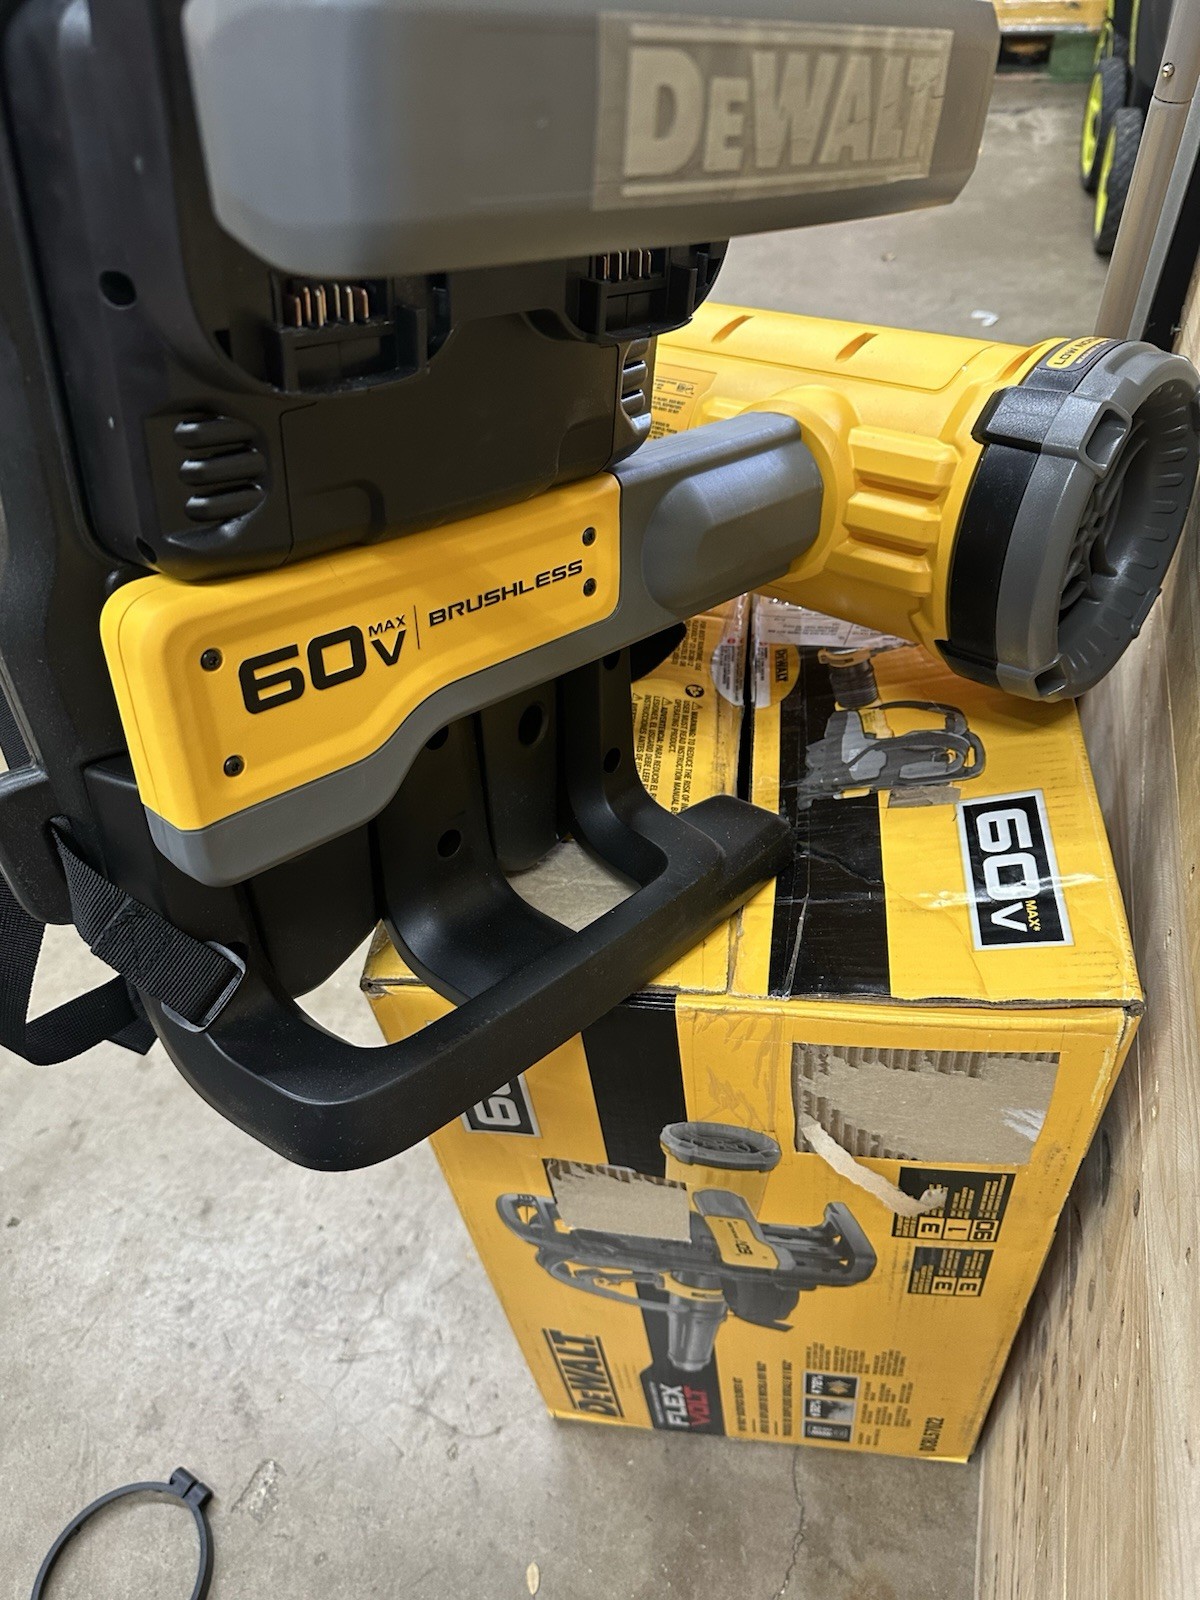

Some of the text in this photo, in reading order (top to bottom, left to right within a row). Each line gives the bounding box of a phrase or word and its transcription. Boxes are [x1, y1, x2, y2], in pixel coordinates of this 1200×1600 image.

[428, 559, 584, 627] BRUSHLESS
[238, 614, 407, 715] 60V MAX
[639, 694, 651, 735] INSTRUCCIONES
[671, 699, 681, 728] OPERATING
[682, 700, 691, 714] USER
[656, 706, 668, 744] ADVERTENCIA:
[680, 714, 689, 730] MUST
[688, 711, 698, 738] WARNING:
[636, 735, 646, 753] ANTES
[678, 730, 687, 745] READ
[643, 753, 653, 768] DEBE
[654, 744, 663, 759] PARA
[685, 746, 695, 768] REDUCE
[651, 759, 661, 784] REDUCIR
[674, 745, 686, 781] INSTRUCTION
[641, 768, 651, 783] LEER
[683, 768, 692, 780] THE
[671, 781, 681, 806] MANUAL
[682, 780, 691, 794] RISK
[681, 794, 690, 803] OF
[976, 808, 1041, 933] 60V
[973, 1221, 995, 1240] 90
[934, 1281, 953, 1291] 3
[959, 1281, 978, 1292] 3
[659, 1383, 691, 1427] FLEX
[684, 1384, 712, 1427] VOLT
